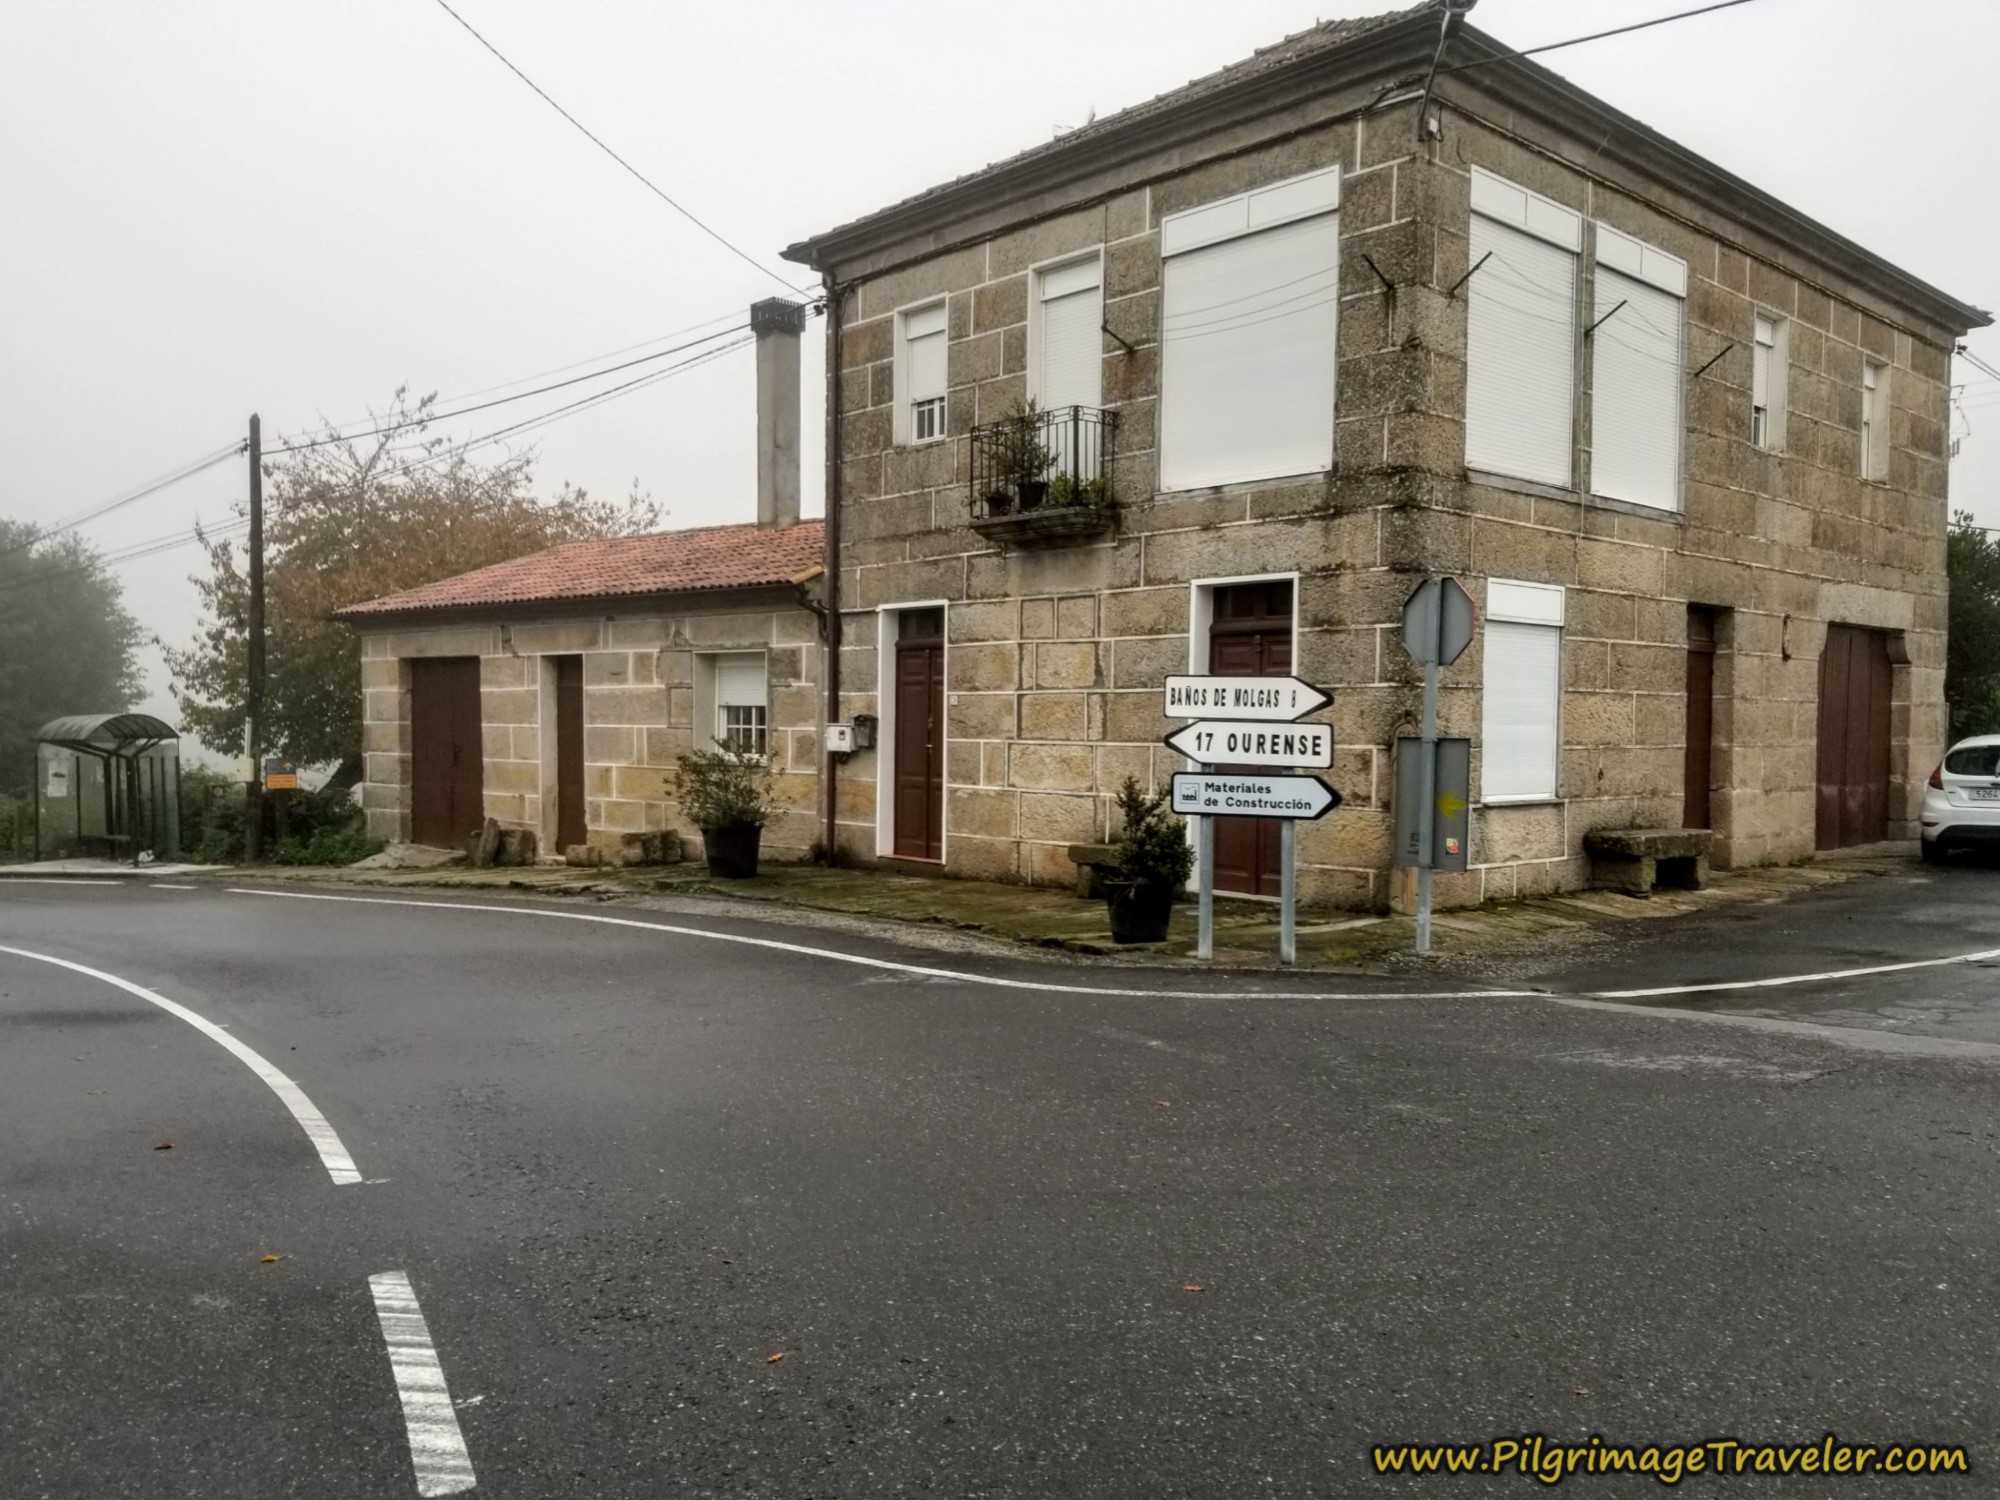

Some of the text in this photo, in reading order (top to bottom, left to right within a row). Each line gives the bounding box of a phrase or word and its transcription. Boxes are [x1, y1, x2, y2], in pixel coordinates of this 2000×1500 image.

[1170, 686, 1207, 706] BAÑOS
[1213, 688, 1226, 707] DE
[1234, 688, 1280, 708] MOLGAS
[1195, 731, 1322, 756] 17 OURENSE
[1204, 782, 1271, 794] Materiales
[1204, 797, 1312, 810] de Construcción
